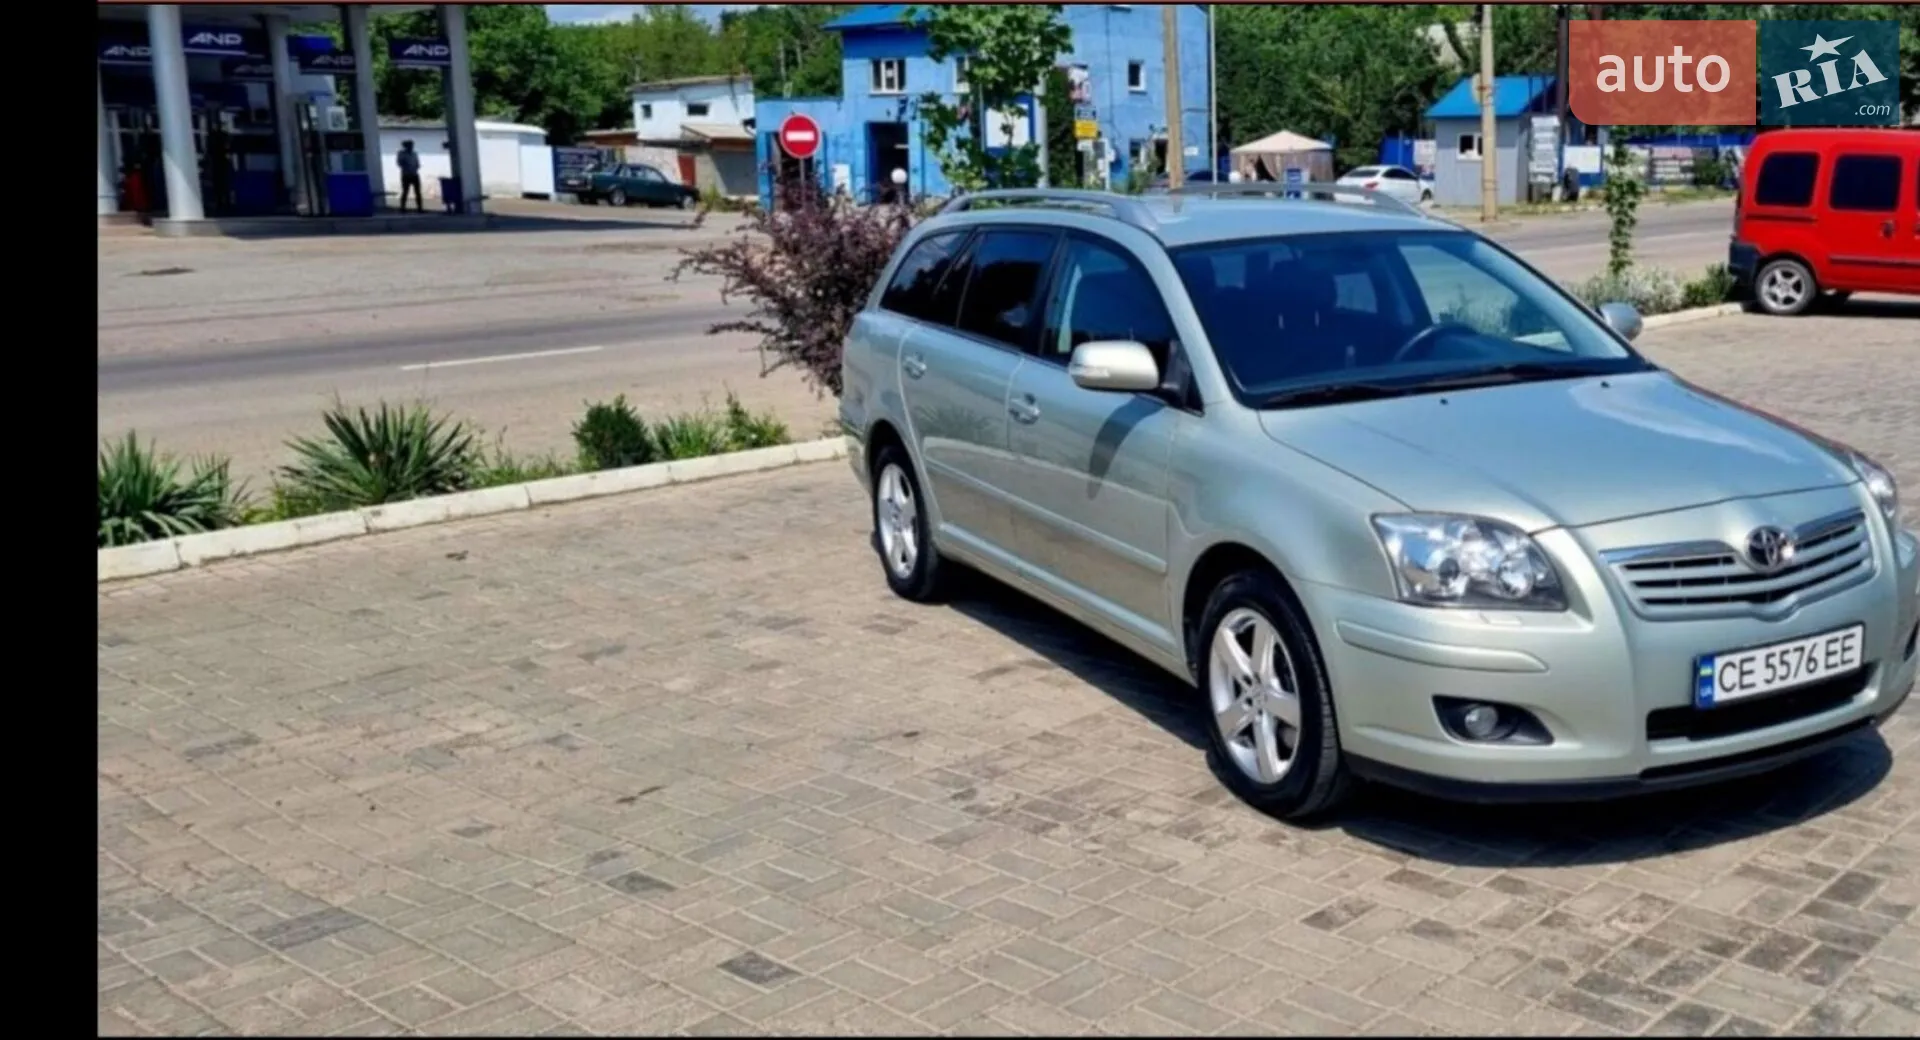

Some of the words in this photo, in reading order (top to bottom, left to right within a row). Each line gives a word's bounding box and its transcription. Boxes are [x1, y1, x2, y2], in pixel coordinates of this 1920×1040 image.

[188, 32, 243, 46] AND
[403, 44, 449, 57] AND
[311, 55, 354, 66] AND
[1718, 656, 1757, 692] CE
[1763, 642, 1818, 685] 5576
[1824, 633, 1856, 670] EE
